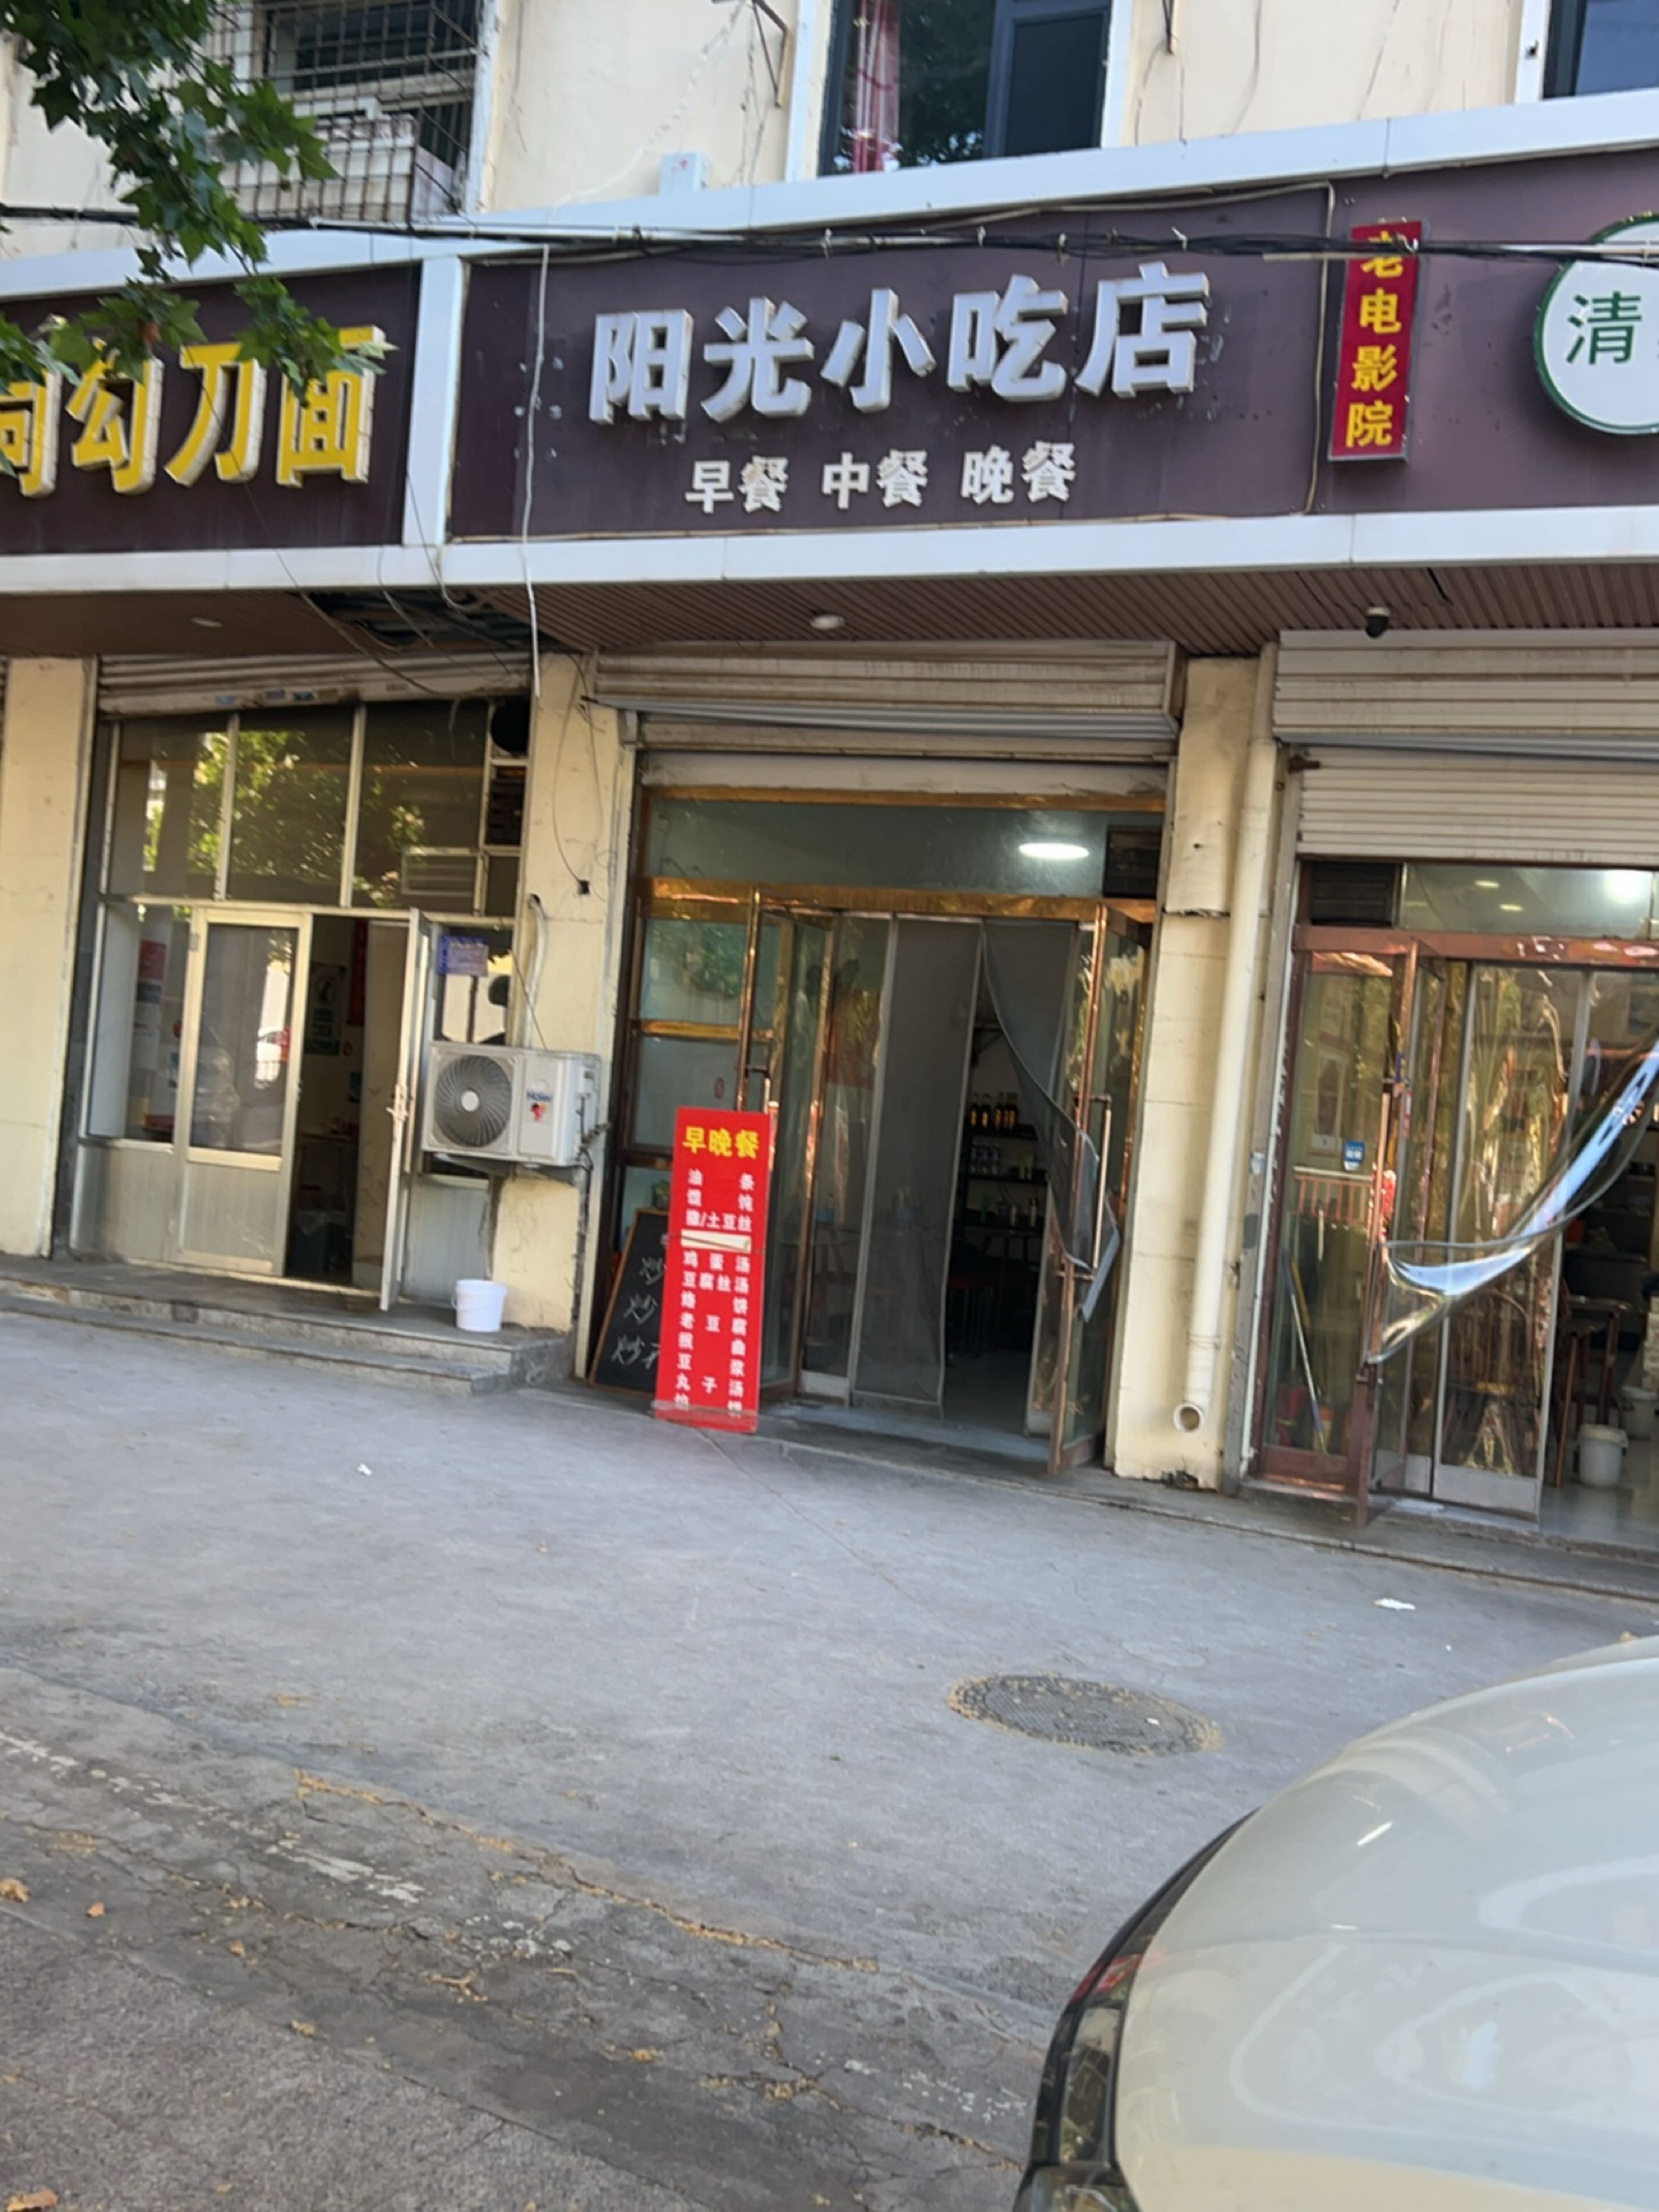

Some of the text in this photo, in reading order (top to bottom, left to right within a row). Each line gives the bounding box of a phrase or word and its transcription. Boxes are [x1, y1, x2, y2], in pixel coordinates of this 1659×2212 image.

[589, 261, 1210, 424] 阳光小吃店
[1345, 230, 1404, 448] 老电影院
[1566, 291, 1642, 365] 清
[685, 440, 1076, 513] 早餐 中餐 晚餐
[682, 1125, 760, 1158] 早晚餐
